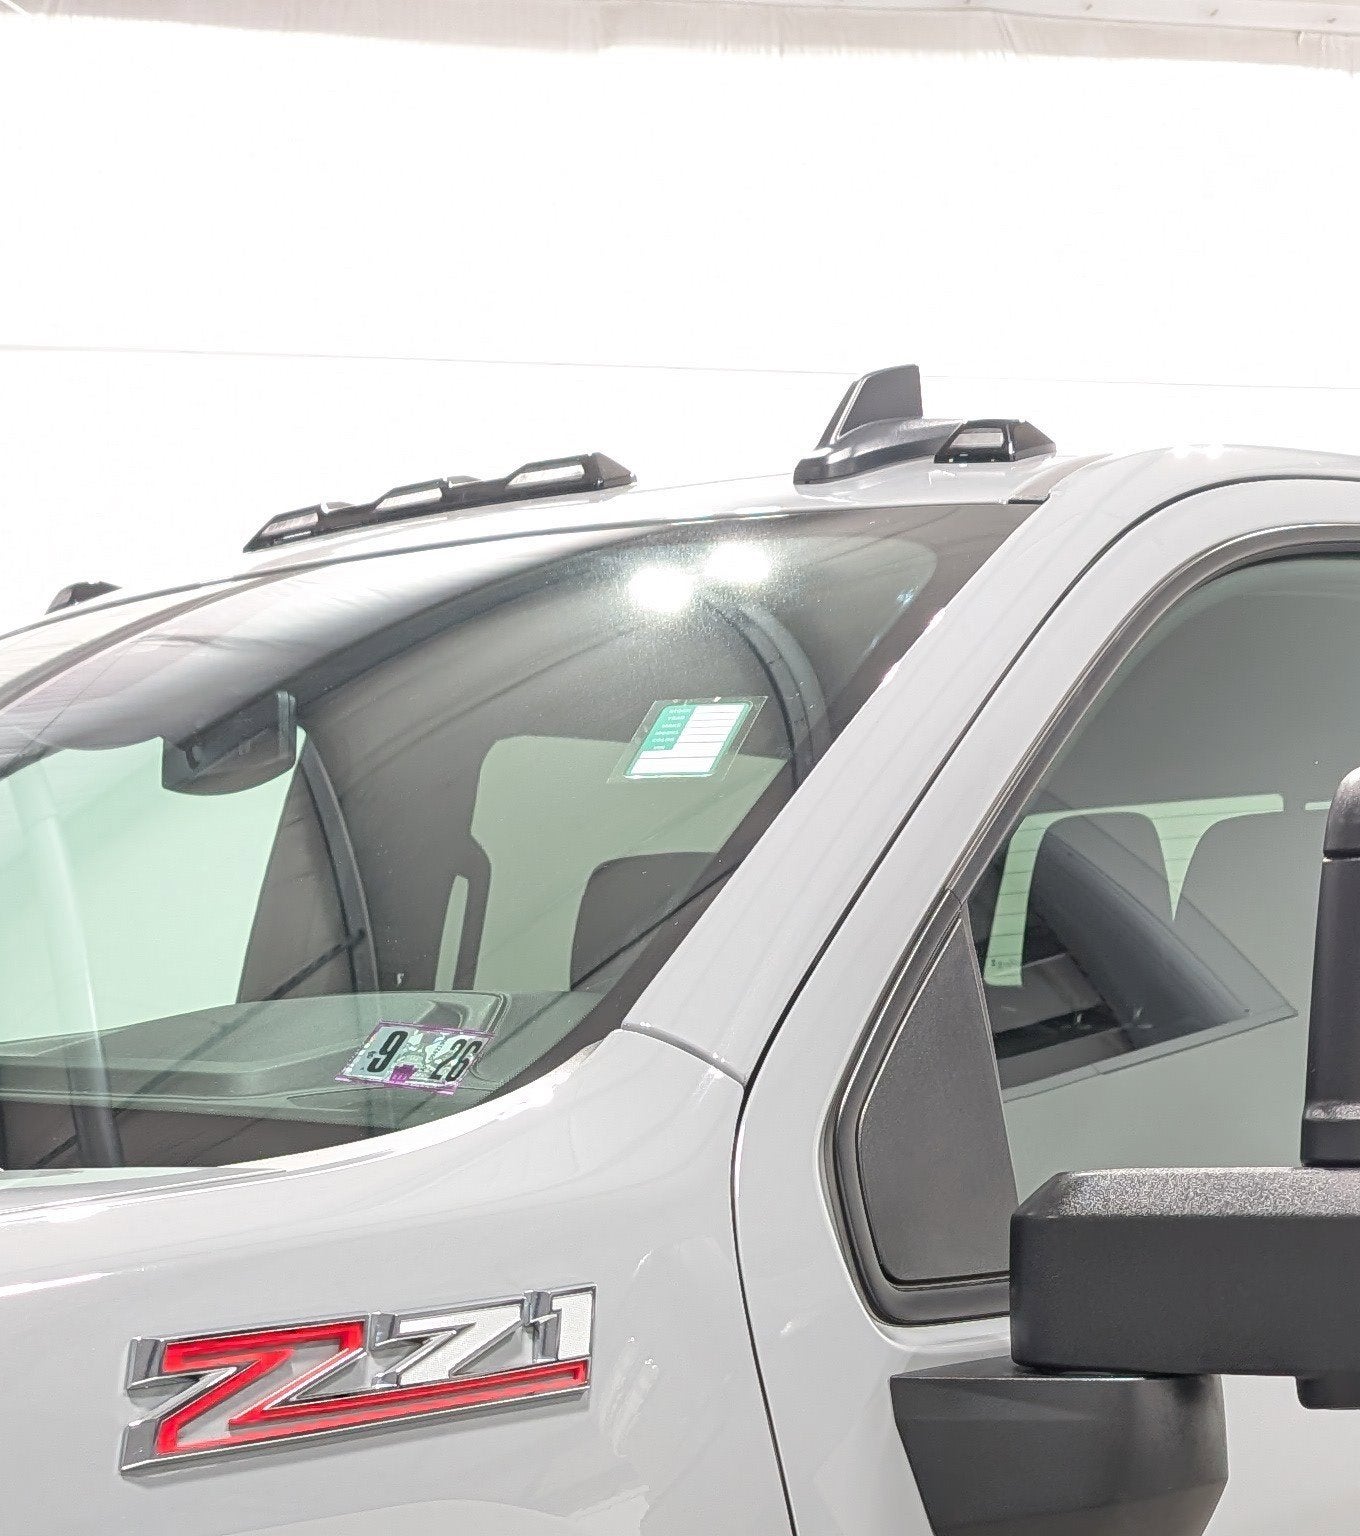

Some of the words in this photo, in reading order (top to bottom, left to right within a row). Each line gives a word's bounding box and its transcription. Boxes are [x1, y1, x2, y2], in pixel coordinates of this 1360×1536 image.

[366, 1030, 409, 1073] 9
[428, 1038, 483, 1082] 26
[119, 1281, 597, 1476] Z71
